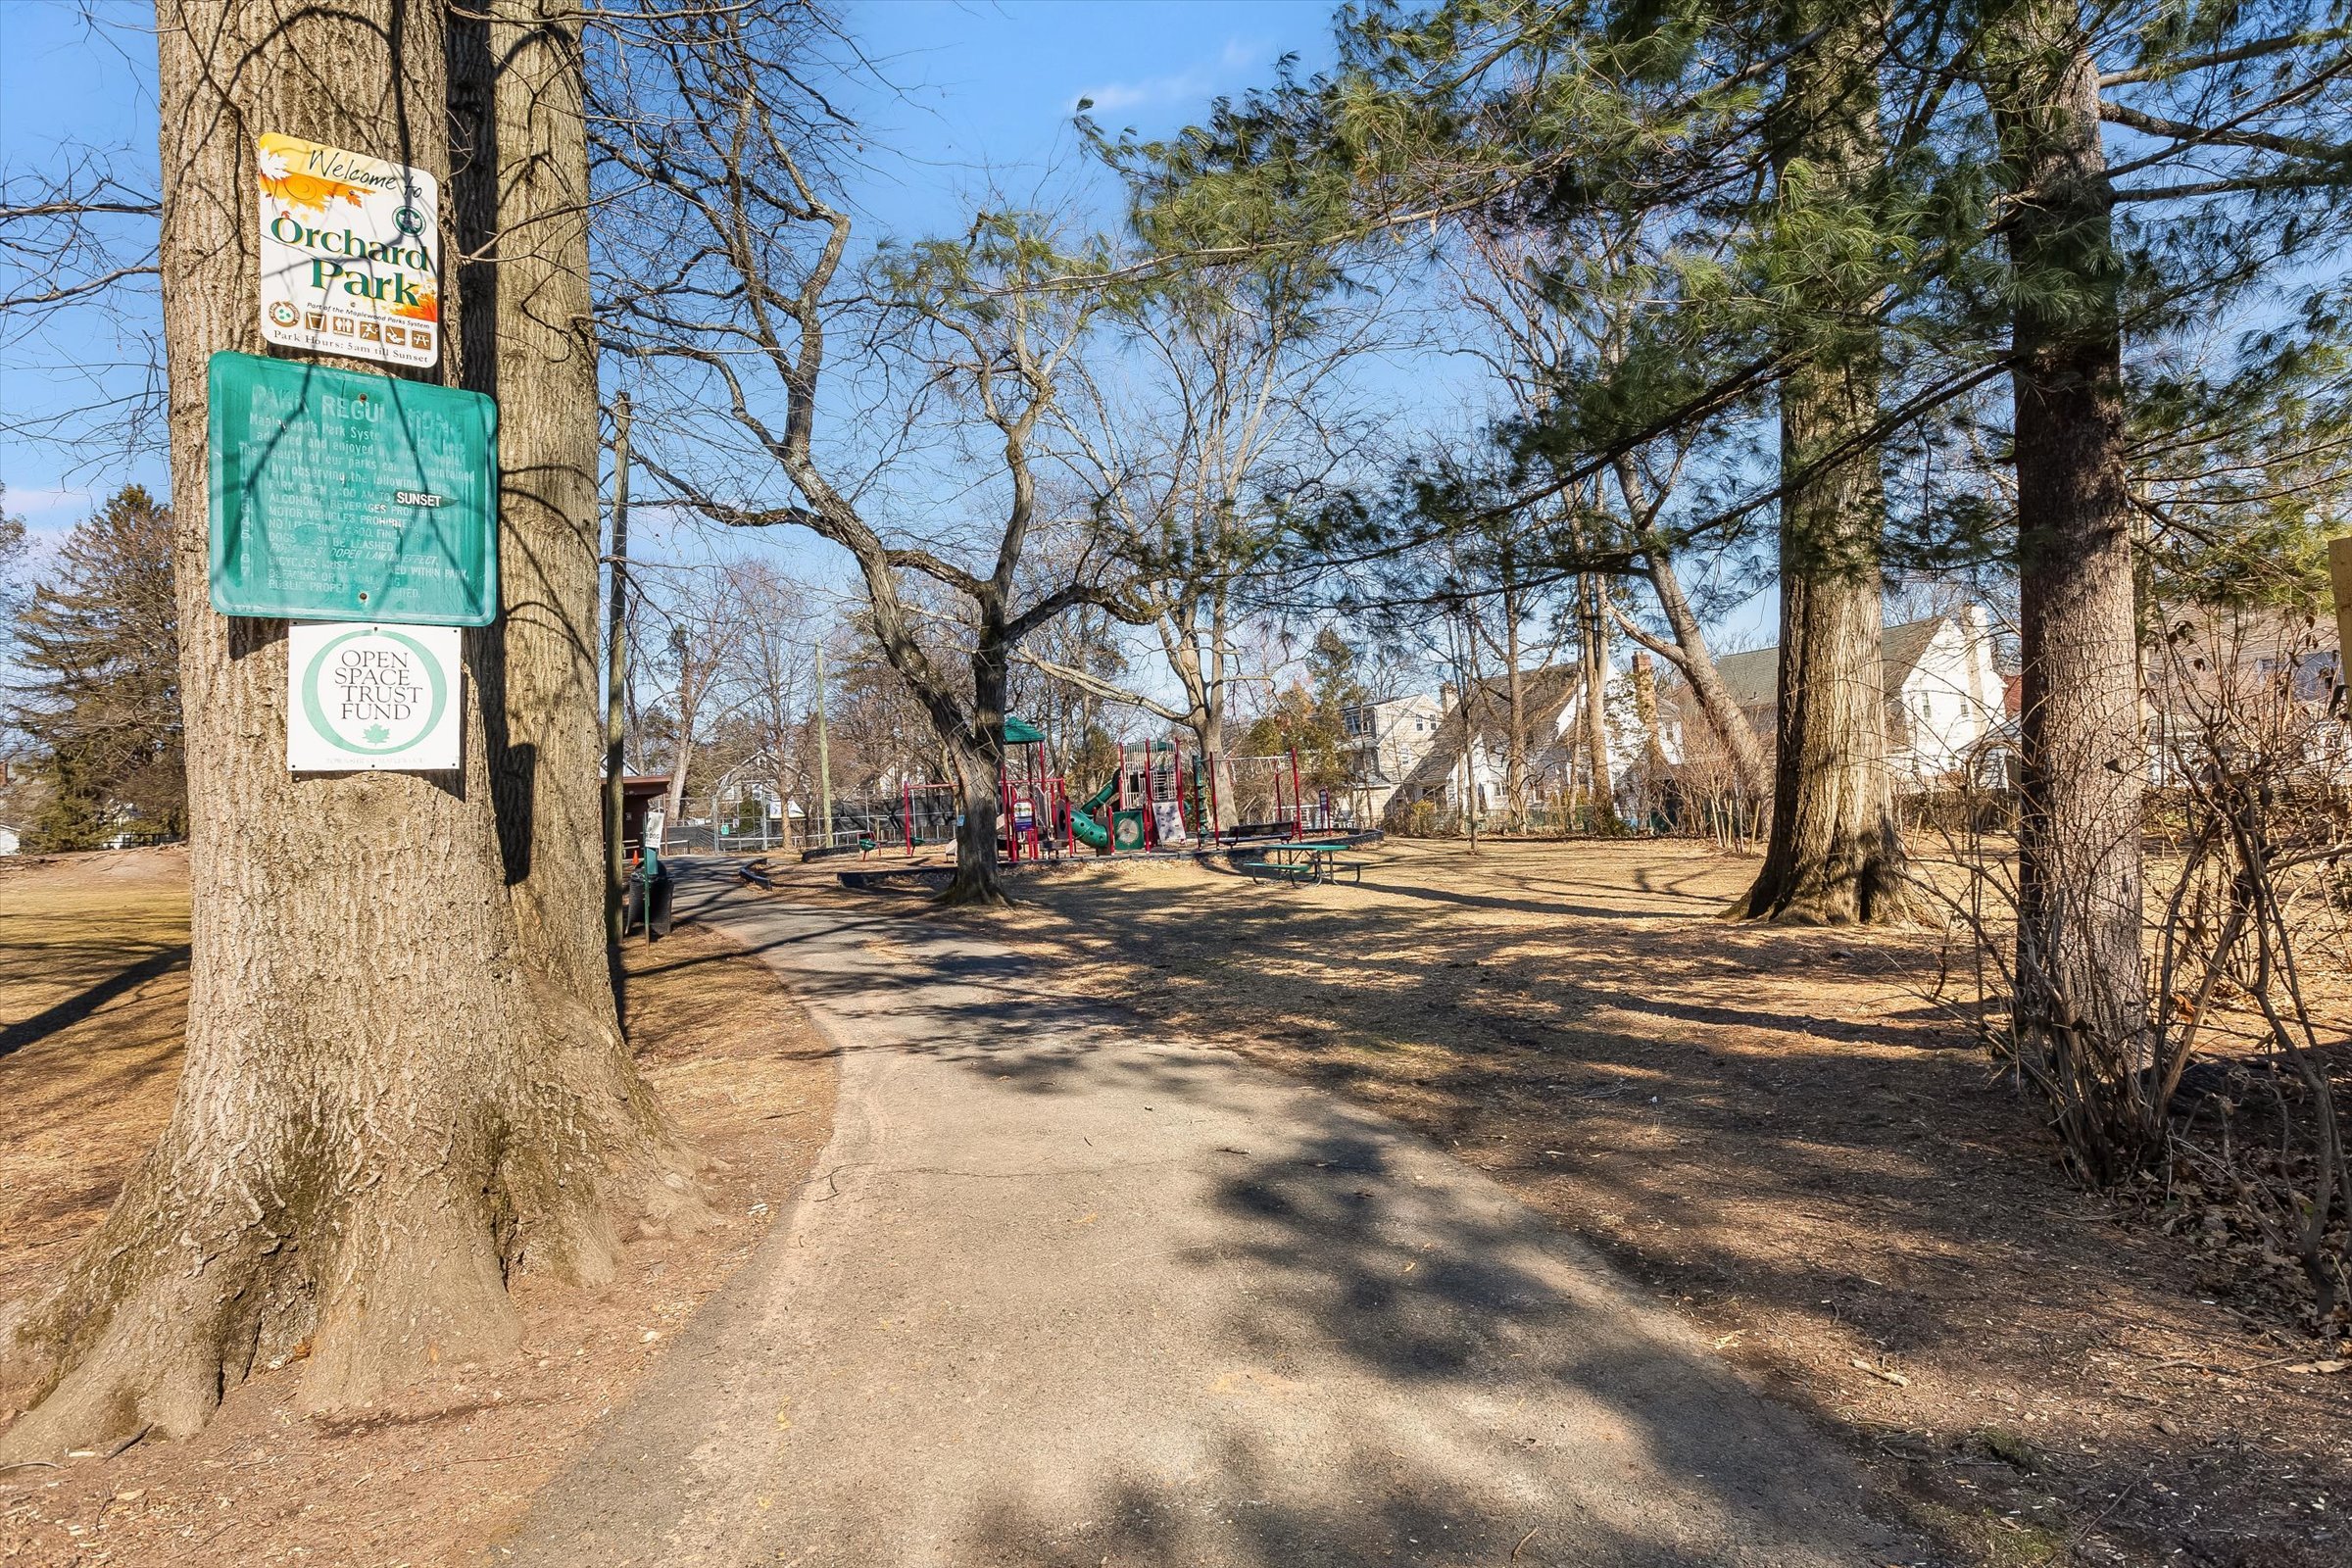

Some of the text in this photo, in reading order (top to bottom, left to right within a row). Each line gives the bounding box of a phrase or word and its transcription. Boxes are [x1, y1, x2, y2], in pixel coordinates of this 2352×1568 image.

[309, 149, 422, 199] Welcome to
[270, 217, 429, 272] Orchard
[311, 258, 419, 307] Park
[307, 302, 322, 311] Part
[323, 304, 331, 313] of
[346, 309, 386, 321] Maplewood
[388, 316, 406, 325] Parks
[407, 318, 430, 329] System
[273, 330, 428, 363] Park Hours: 5am till Sunset
[308, 438, 327, 449] and
[333, 440, 374, 457] enjoyed
[349, 457, 376, 470] parks
[291, 466, 346, 484] observing
[270, 492, 323, 508] ALCOHOLIC
[329, 499, 387, 514] BEVERAGES
[396, 491, 442, 508] SUNSET
[269, 506, 303, 519] MOTOR
[268, 518, 283, 530] NO
[269, 532, 297, 543] DOGS
[341, 650, 408, 668] OPEN
[334, 667, 411, 686] SPACE
[340, 685, 423, 704] TRUST
[341, 703, 411, 720] FUND
